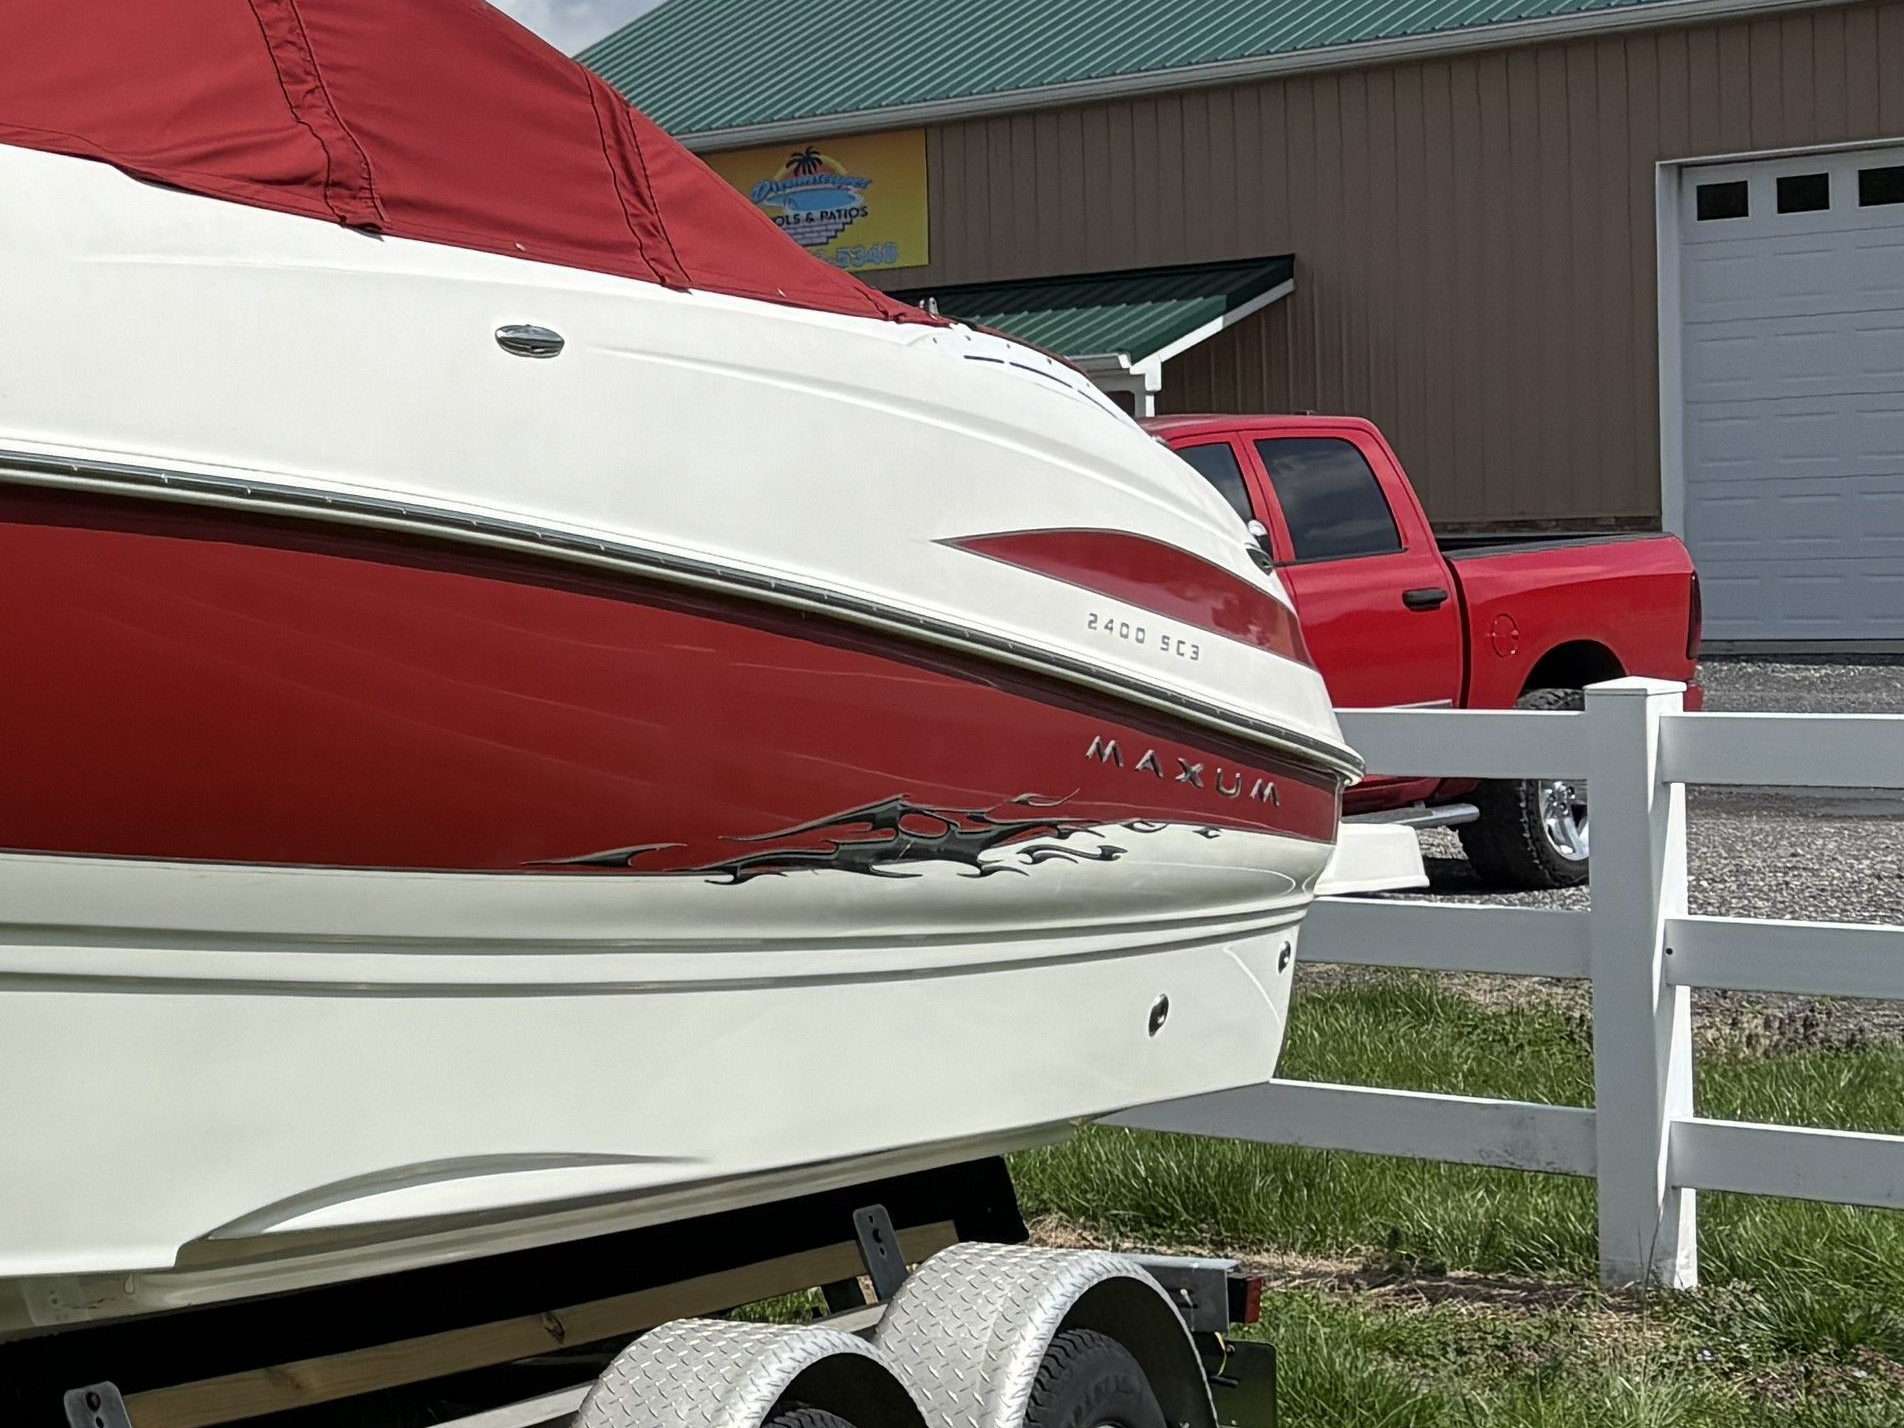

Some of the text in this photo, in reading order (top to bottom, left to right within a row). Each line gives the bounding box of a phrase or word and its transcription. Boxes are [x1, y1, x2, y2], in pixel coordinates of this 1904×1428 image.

[805, 212, 815, 222] &
[820, 205, 869, 221] PATIOS
[1087, 613, 1201, 661] 2400 SC3
[1084, 735, 1280, 808] MAXUM
